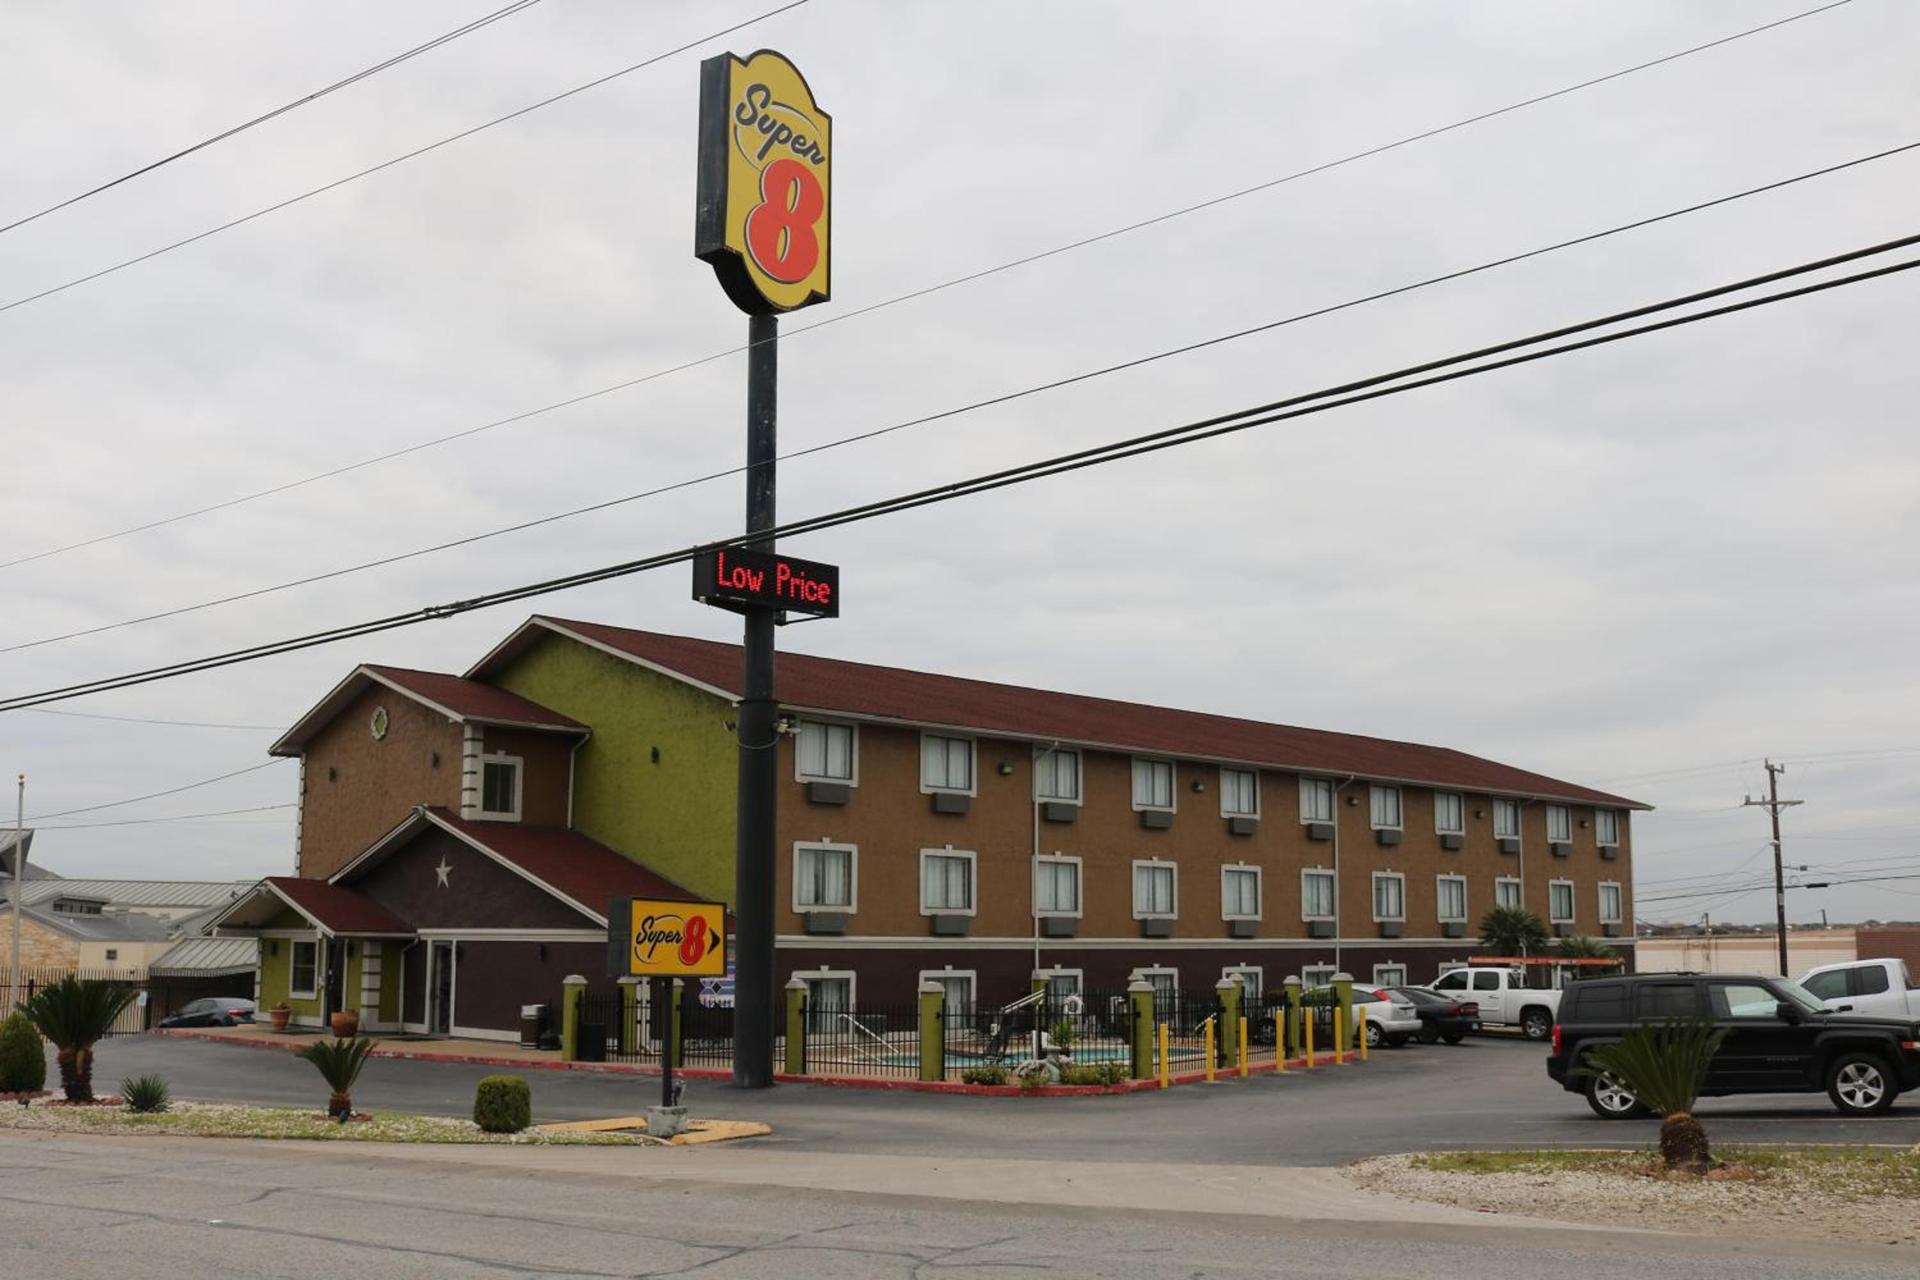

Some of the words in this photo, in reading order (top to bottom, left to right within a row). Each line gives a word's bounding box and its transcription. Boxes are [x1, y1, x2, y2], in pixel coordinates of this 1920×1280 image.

[735, 83, 825, 165] Super
[744, 158, 824, 284] 8
[718, 551, 764, 592] Low
[776, 562, 831, 604] Price
[636, 915, 683, 959] Super
[679, 915, 707, 966] 8
